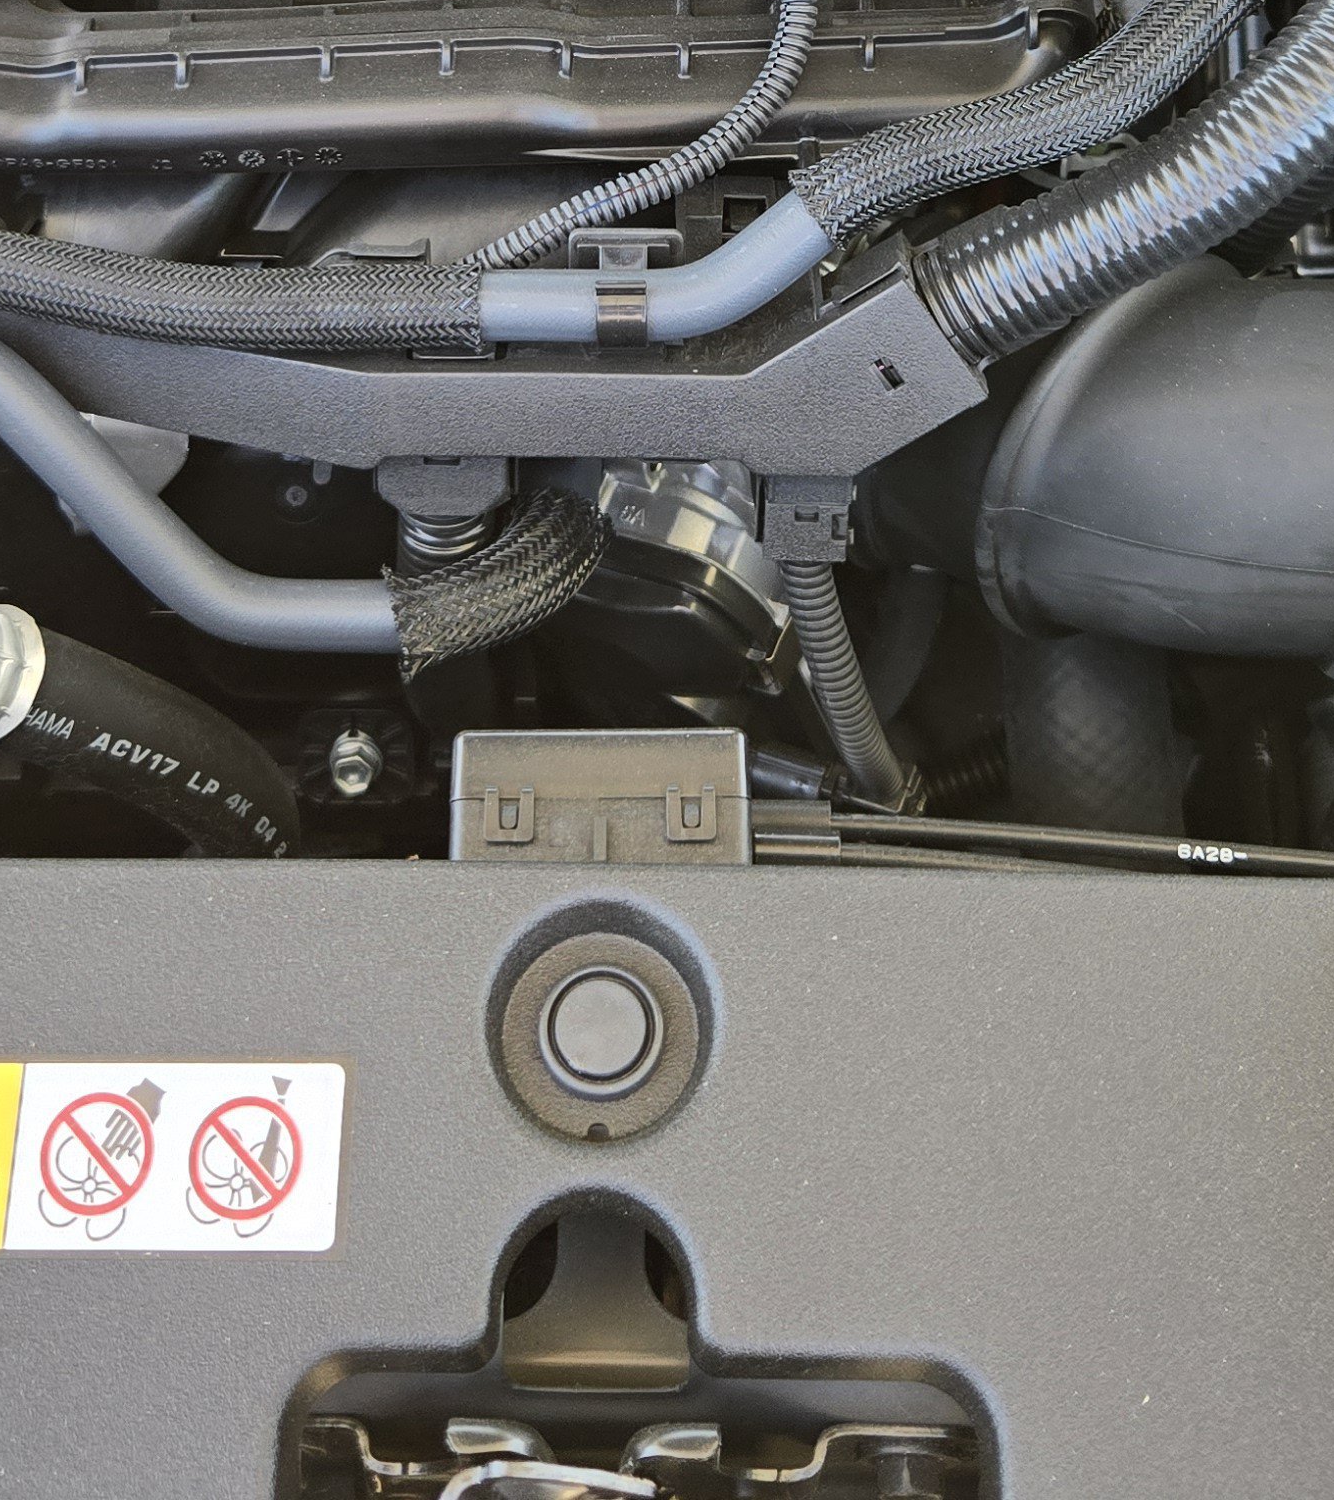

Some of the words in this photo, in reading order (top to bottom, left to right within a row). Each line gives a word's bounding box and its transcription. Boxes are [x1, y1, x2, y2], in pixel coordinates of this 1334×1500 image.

[25, 706, 75, 740] HAMA
[88, 732, 180, 776] ACV17
[186, 770, 220, 796] LP
[224, 792, 254, 818] 4K
